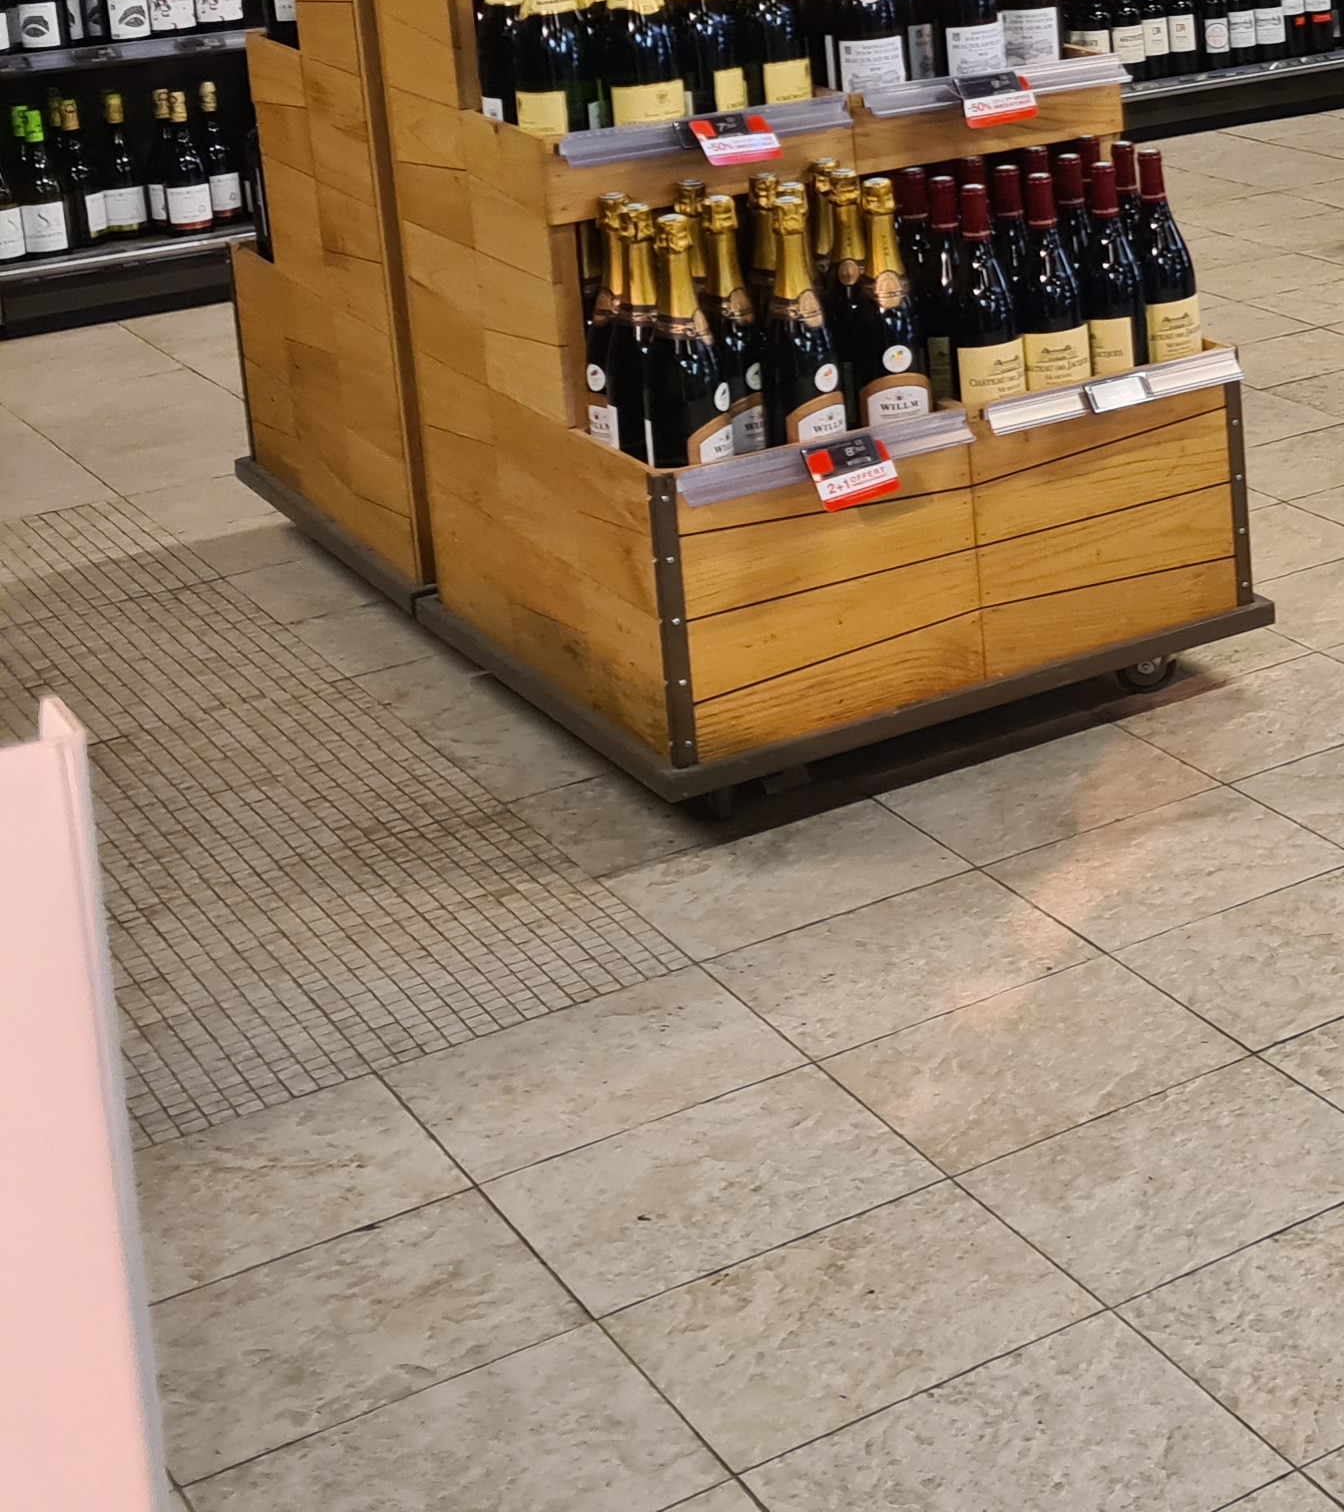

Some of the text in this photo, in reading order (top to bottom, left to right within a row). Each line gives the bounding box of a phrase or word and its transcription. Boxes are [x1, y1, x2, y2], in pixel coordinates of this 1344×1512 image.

[967, 101, 991, 113] -50%
[707, 141, 734, 152] -50%
[879, 400, 920, 412] WILLM
[826, 467, 886, 494] 2+1 OFFERT
